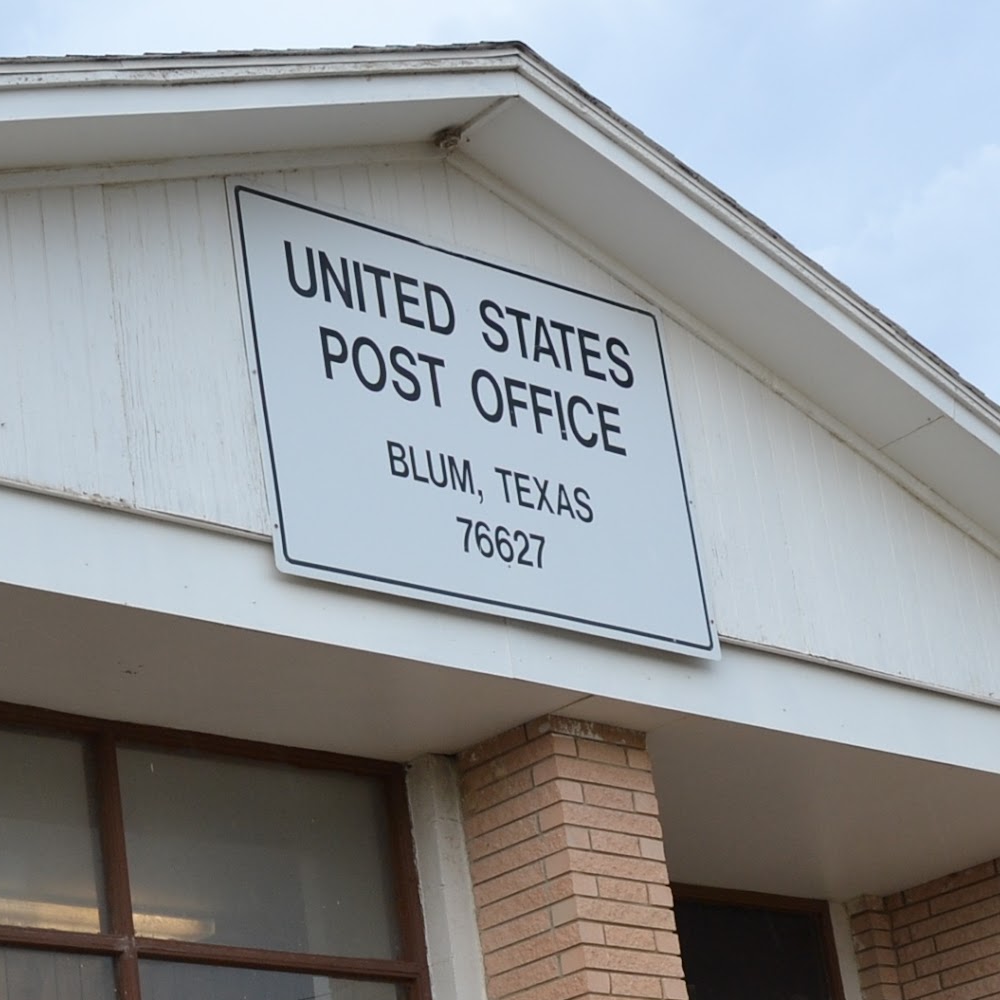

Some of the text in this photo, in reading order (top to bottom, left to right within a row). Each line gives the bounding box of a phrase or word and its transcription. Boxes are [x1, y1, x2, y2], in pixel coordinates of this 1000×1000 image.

[283, 240, 635, 388] UNITED STATES
[319, 326, 627, 456] POST OFFICE
[386, 440, 594, 523] BLUM, TEXAS
[456, 516, 547, 569] 76627
